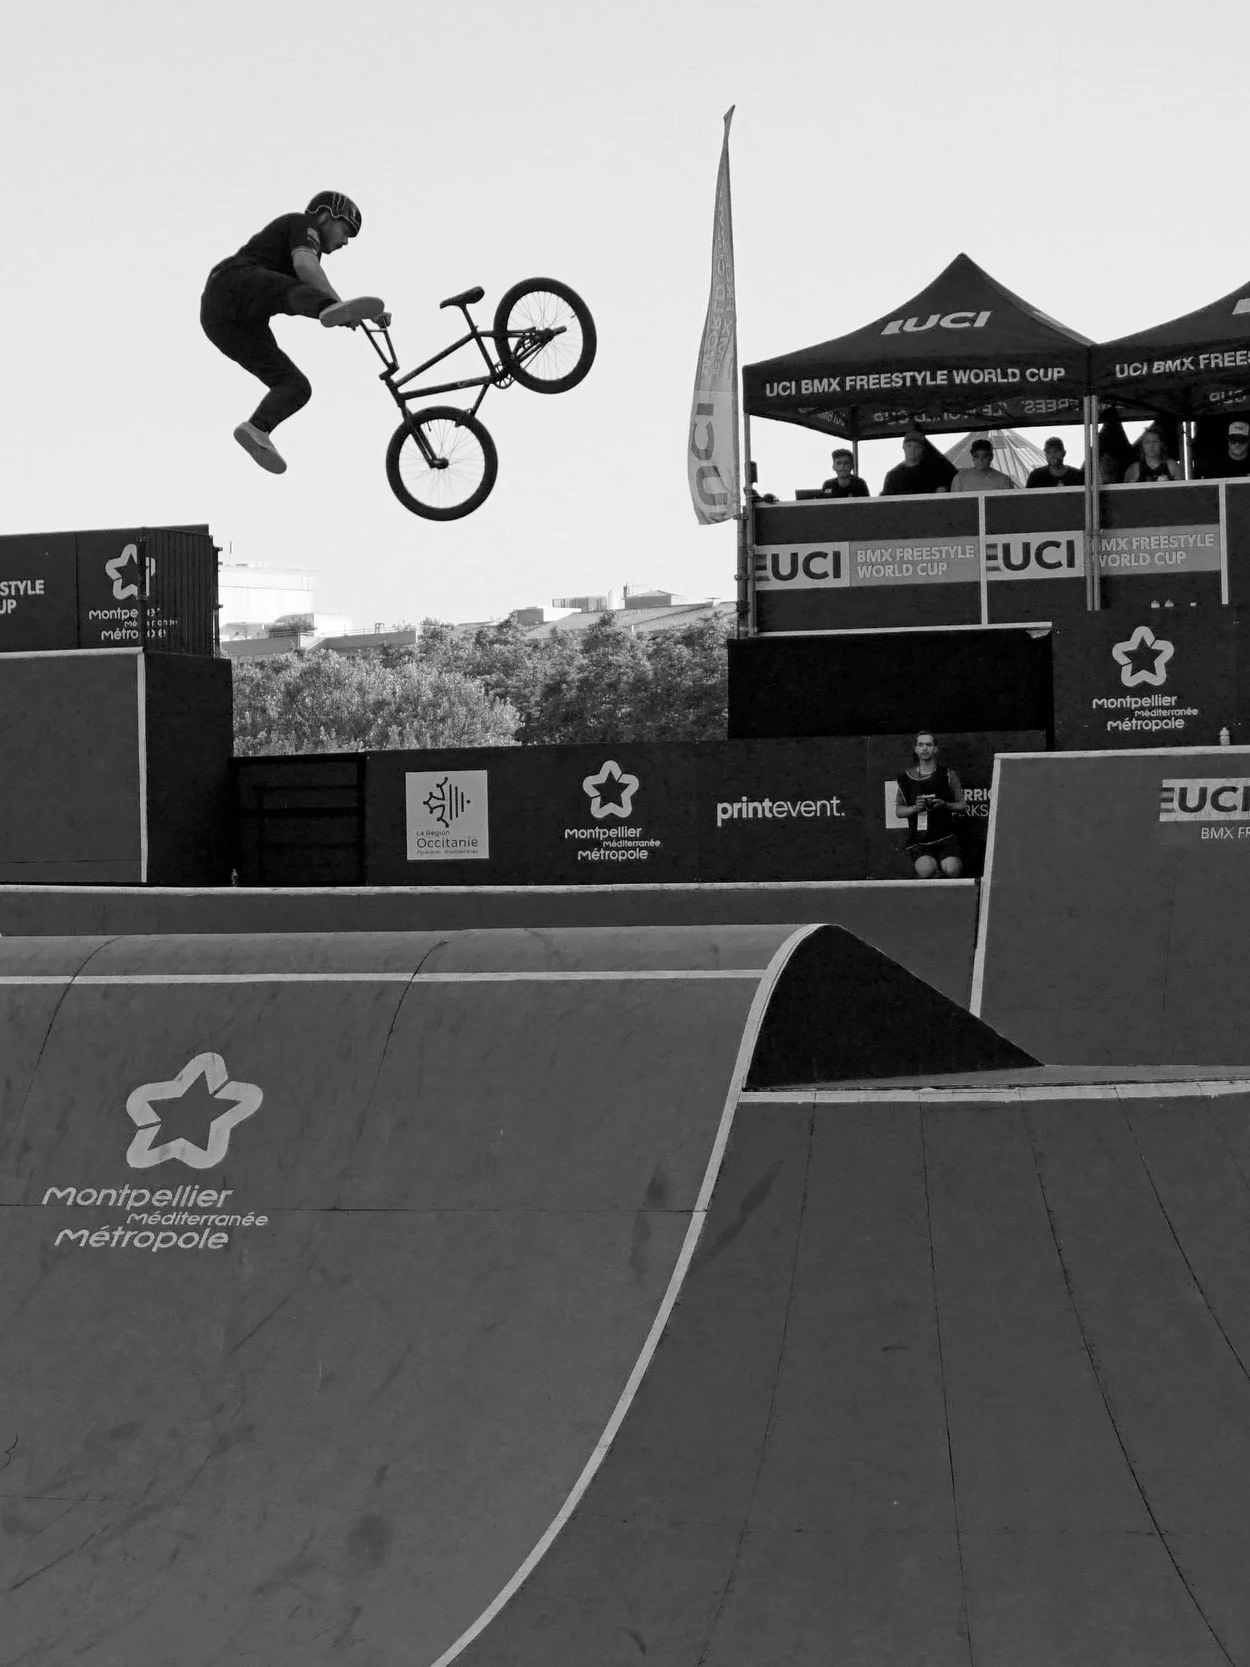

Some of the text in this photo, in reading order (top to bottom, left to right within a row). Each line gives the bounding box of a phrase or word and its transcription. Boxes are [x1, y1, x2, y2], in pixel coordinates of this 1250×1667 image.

[903, 311, 992, 332] UCI
[1115, 350, 1250, 378] UCI BMX FREE
[766, 367, 1066, 396] UCI BMX FREESTYLE WORLD CUP
[1092, 533, 1215, 553] MX FREESTYLE
[857, 545, 975, 563] BMX FREESTYLE
[1002, 540, 1076, 571] UCI
[1154, 551, 1187, 566] CUP
[771, 551, 841, 581] UCI
[857, 562, 948, 578] WORLD CUP
[1178, 786, 1250, 813] UCI
[717, 796, 846, 827] printevent.
[952, 804, 989, 817] RKS
[416, 836, 479, 848] Occitanie
[1201, 827, 1234, 839] BMX
